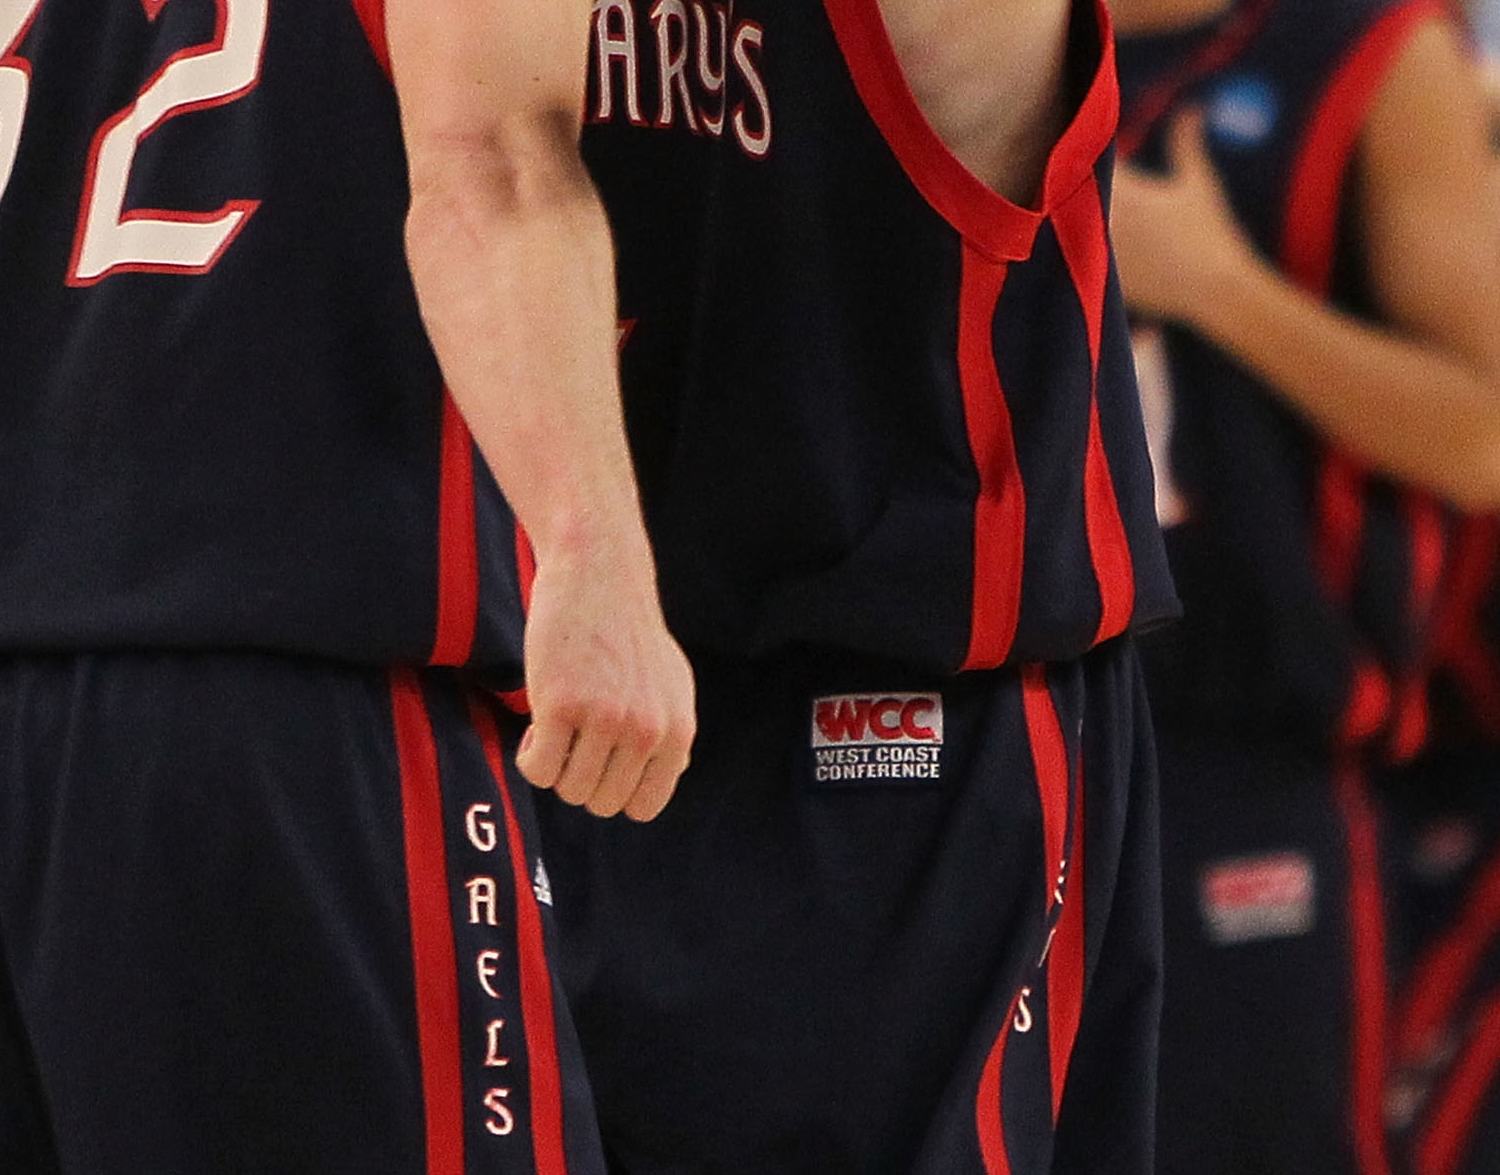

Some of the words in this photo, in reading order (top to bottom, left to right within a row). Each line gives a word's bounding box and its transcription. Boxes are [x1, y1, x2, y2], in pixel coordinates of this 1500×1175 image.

[816, 697, 940, 743] WCC
[816, 747, 871, 764] WEST
[875, 746, 941, 762] COAST
[816, 763, 940, 781] CONFERENCE
[465, 802, 515, 1137] GAELS
